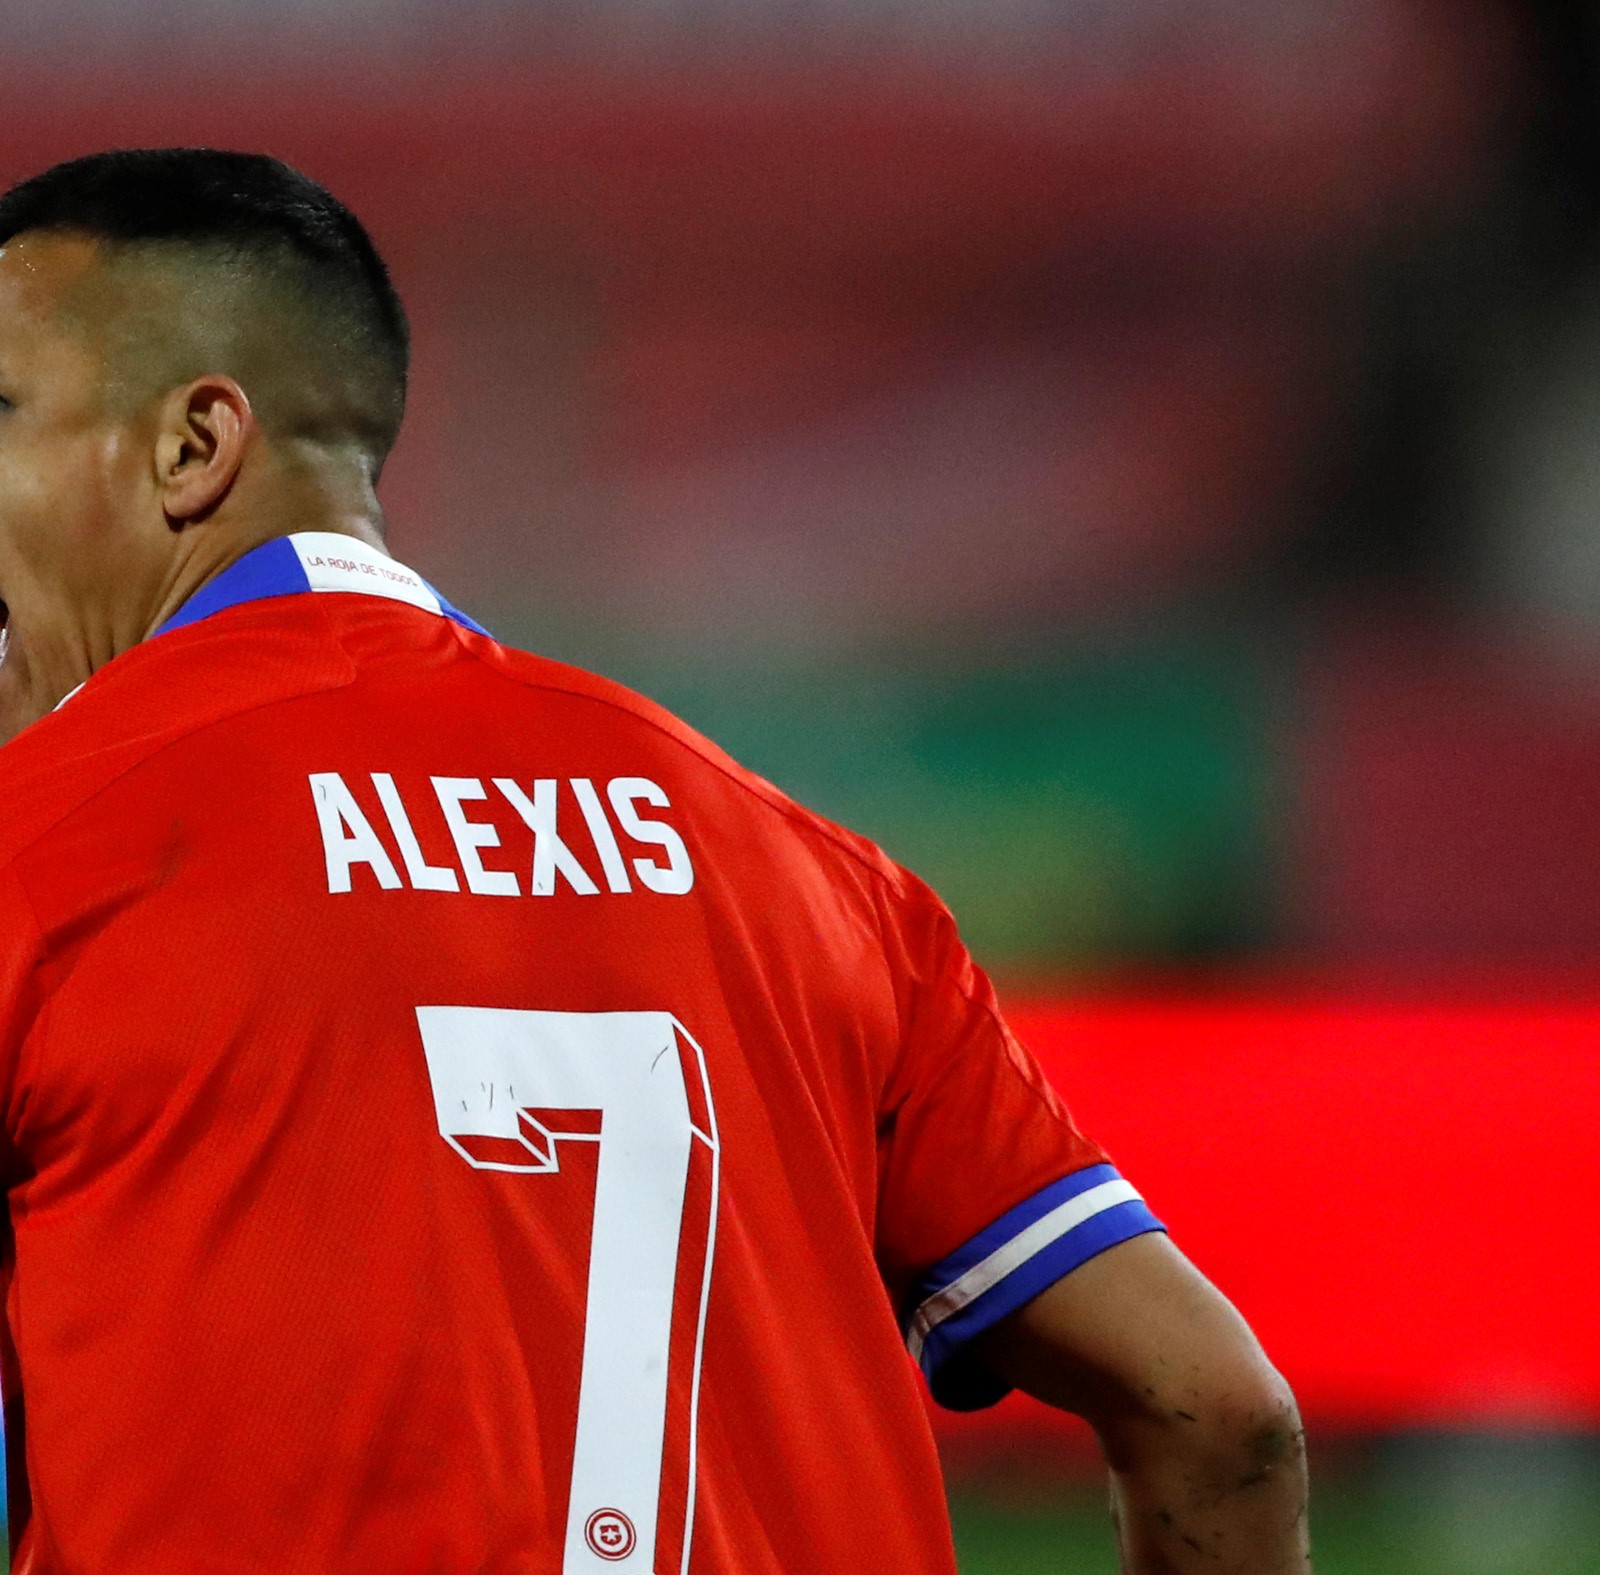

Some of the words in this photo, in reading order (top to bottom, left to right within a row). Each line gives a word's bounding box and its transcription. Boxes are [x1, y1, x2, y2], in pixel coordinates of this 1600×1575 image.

[306, 556, 326, 567] LA
[327, 557, 359, 573] ROJA
[360, 563, 378, 576] DE
[308, 772, 695, 897] ALEXIS
[414, 1005, 720, 1575] 7
